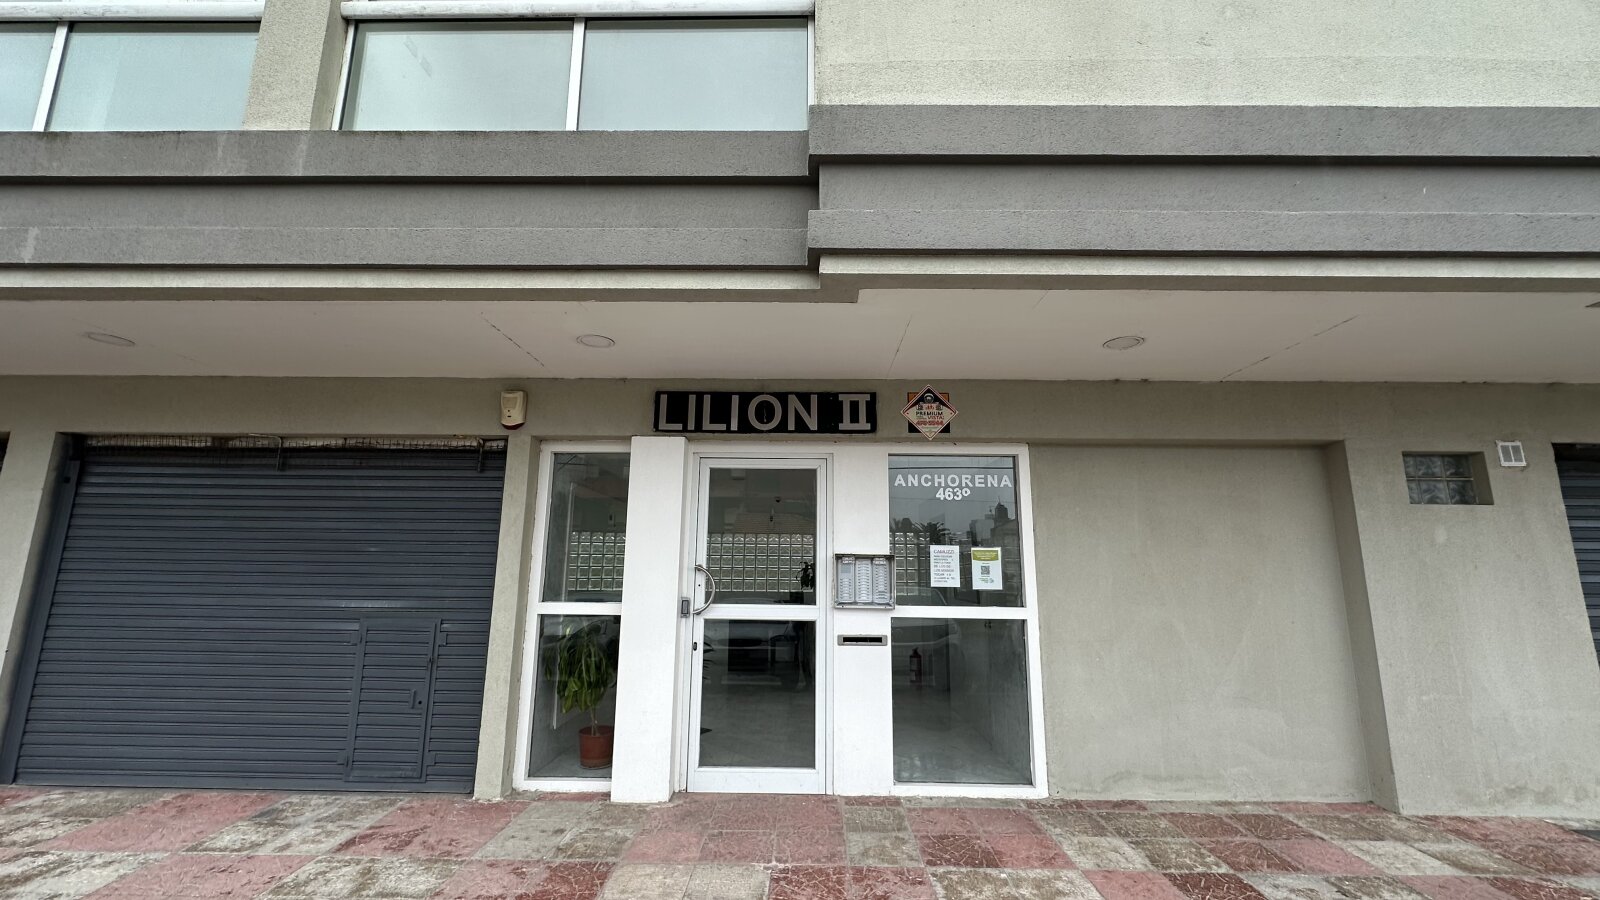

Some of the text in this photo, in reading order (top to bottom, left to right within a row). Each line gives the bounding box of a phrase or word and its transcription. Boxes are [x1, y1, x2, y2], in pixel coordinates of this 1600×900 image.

[658, 393, 871, 431] LILION II
[894, 474, 1013, 488] ANCHORENA
